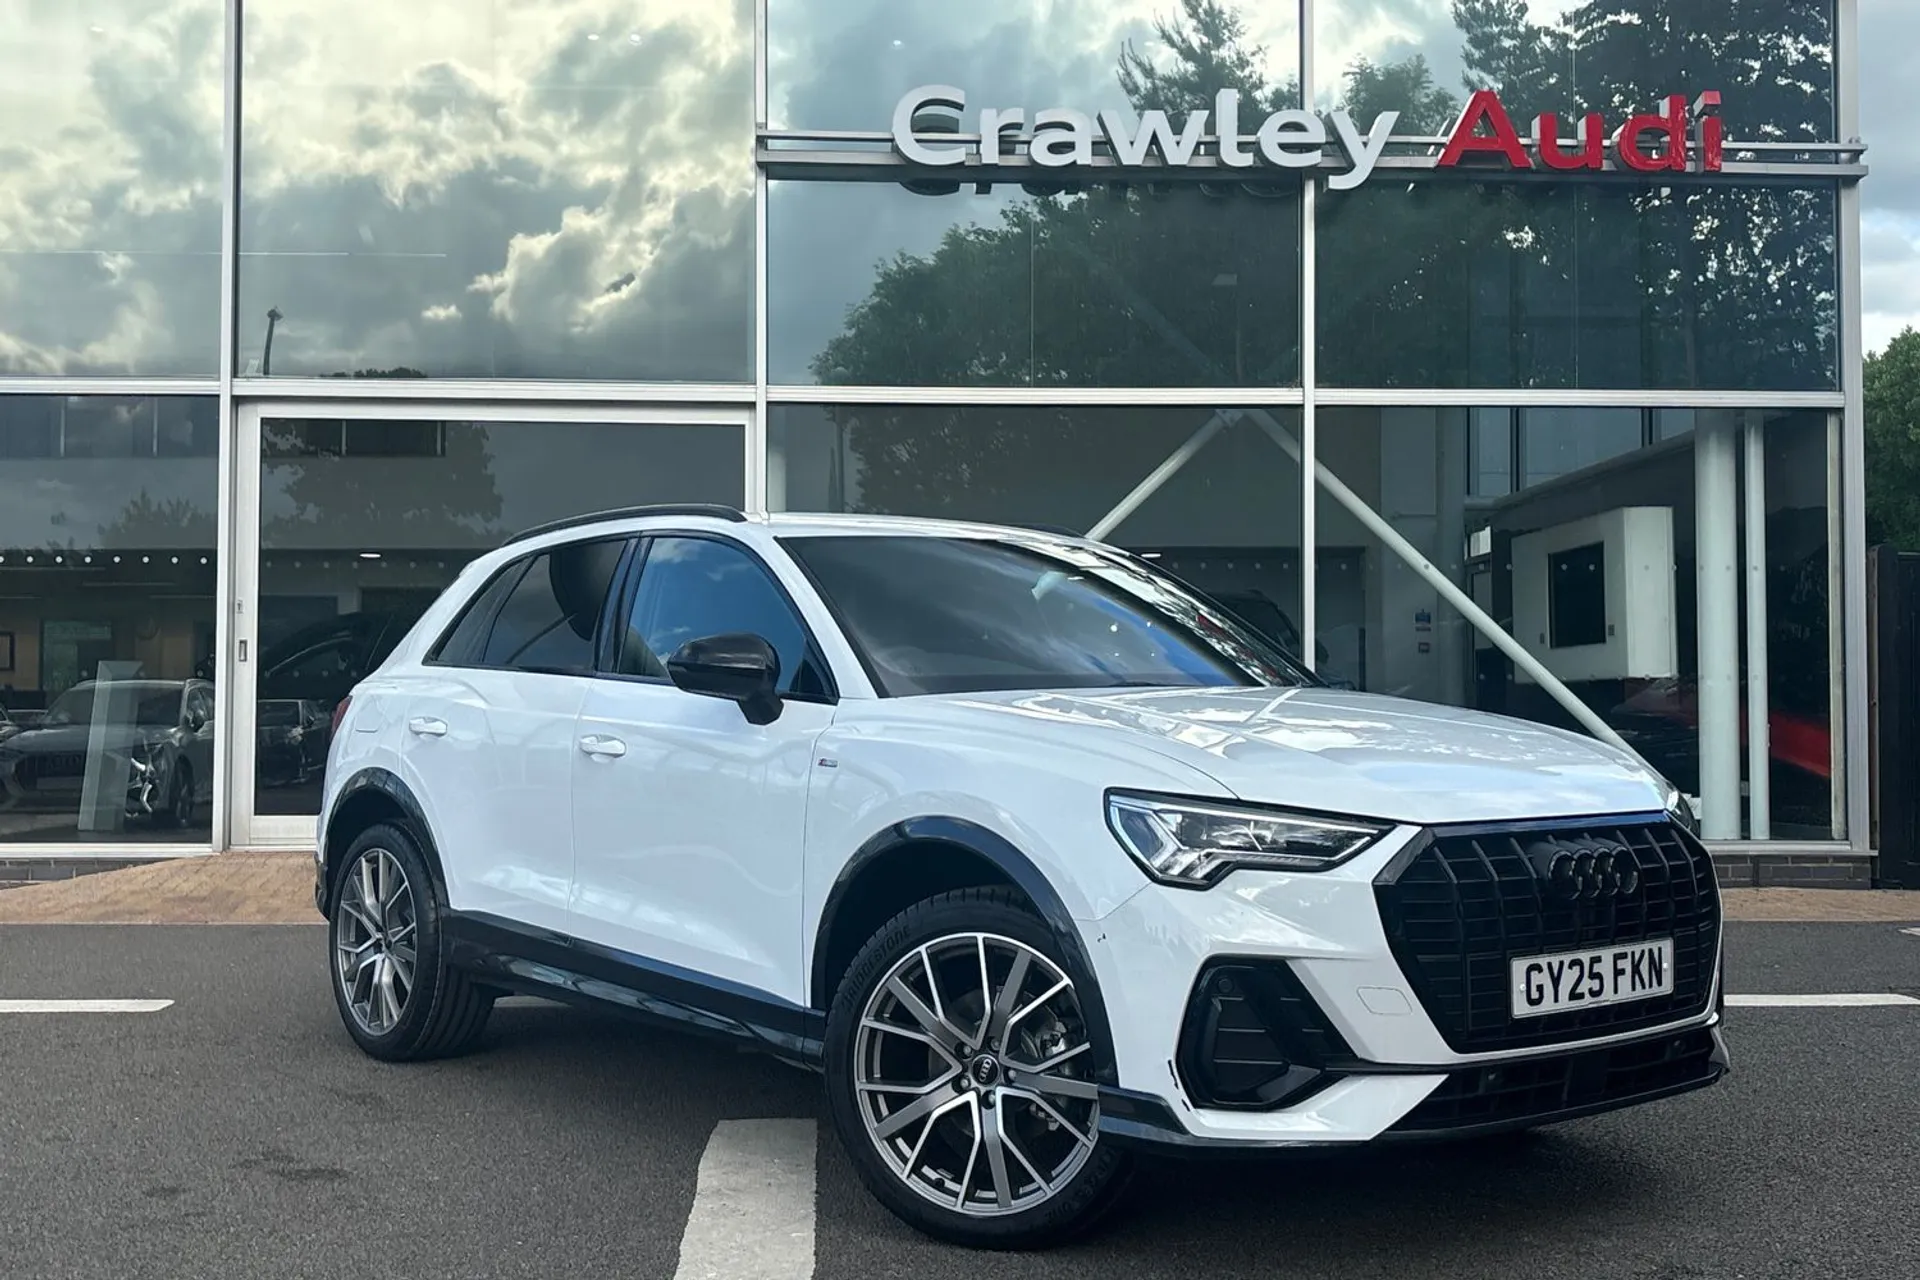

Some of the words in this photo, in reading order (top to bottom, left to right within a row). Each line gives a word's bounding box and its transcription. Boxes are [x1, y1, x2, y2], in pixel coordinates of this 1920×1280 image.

[892, 85, 1399, 190] Crawley
[1436, 91, 1721, 171] Audi
[1525, 955, 1604, 1007] GY25
[1612, 946, 1664, 995] FKN
